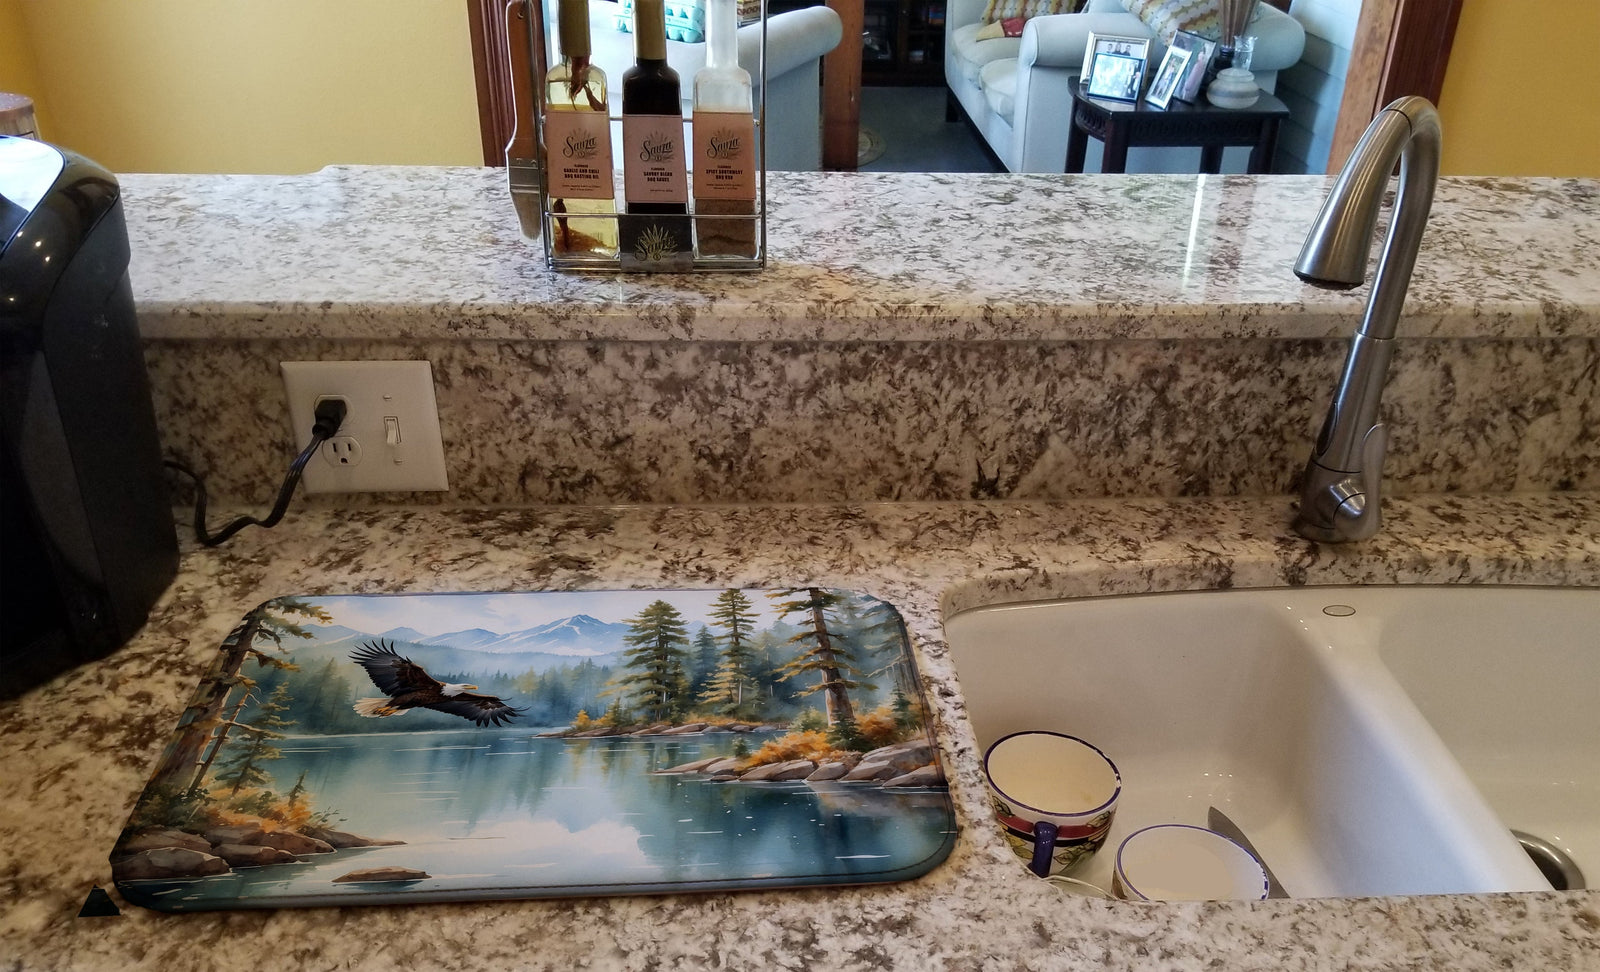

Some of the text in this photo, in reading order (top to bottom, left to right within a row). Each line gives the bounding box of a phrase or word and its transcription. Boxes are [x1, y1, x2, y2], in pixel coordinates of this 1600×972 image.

[562, 136, 597, 158] Sauza
[640, 140, 674, 162] Sauza
[707, 136, 741, 159] Sauza
